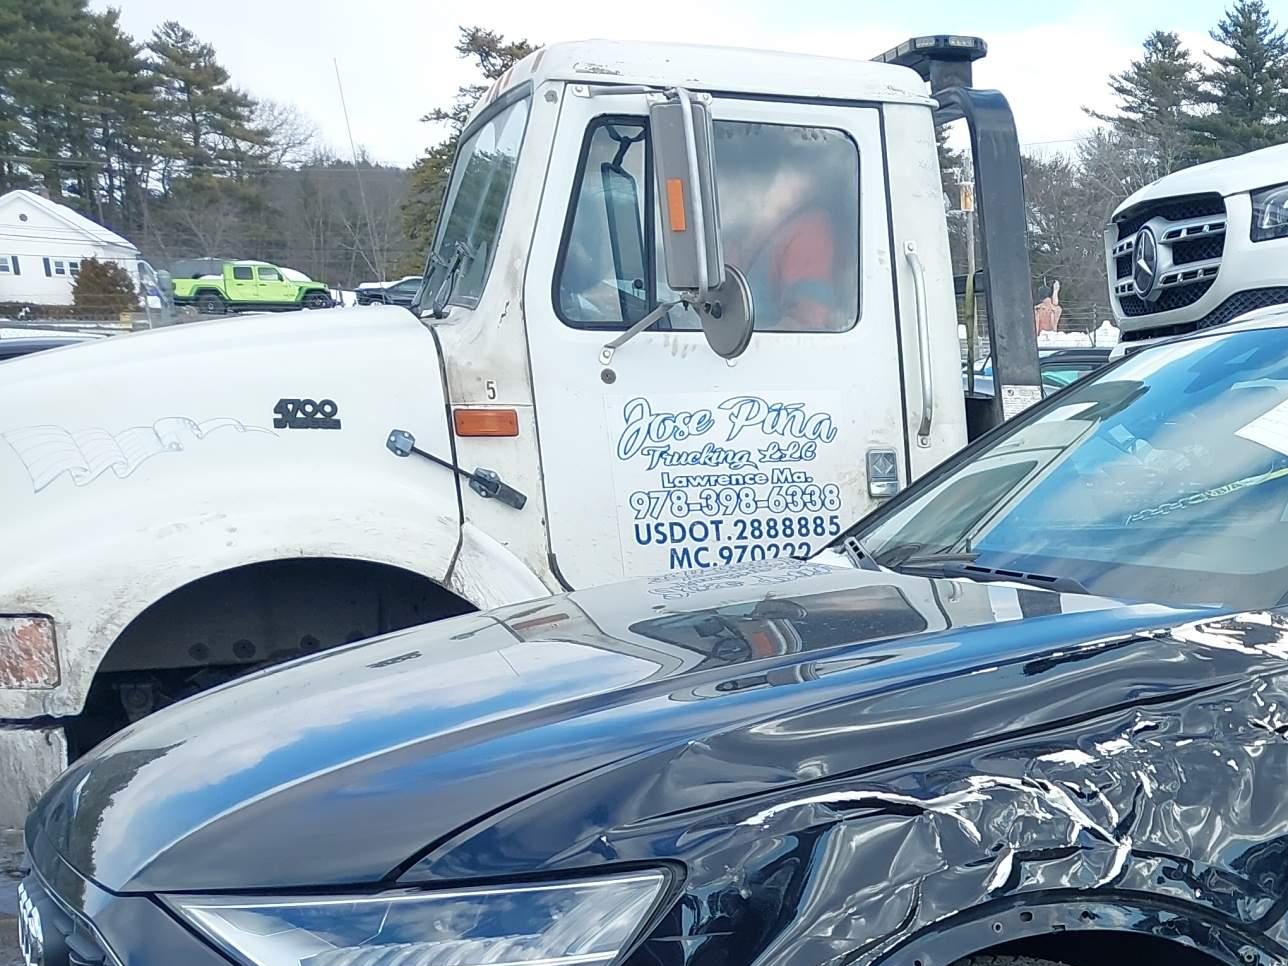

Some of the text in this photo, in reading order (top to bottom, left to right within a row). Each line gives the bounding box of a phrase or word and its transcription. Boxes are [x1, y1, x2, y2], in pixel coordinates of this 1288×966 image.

[486, 380, 496, 400] 5
[273, 398, 338, 419] 4700
[617, 395, 838, 461] Jose Piña
[641, 441, 817, 471] Trucking LLC
[661, 468, 814, 489] Lawrence Ma.
[629, 483, 841, 520] 978-398-6338
[634, 515, 841, 546] USDOT.2888885
